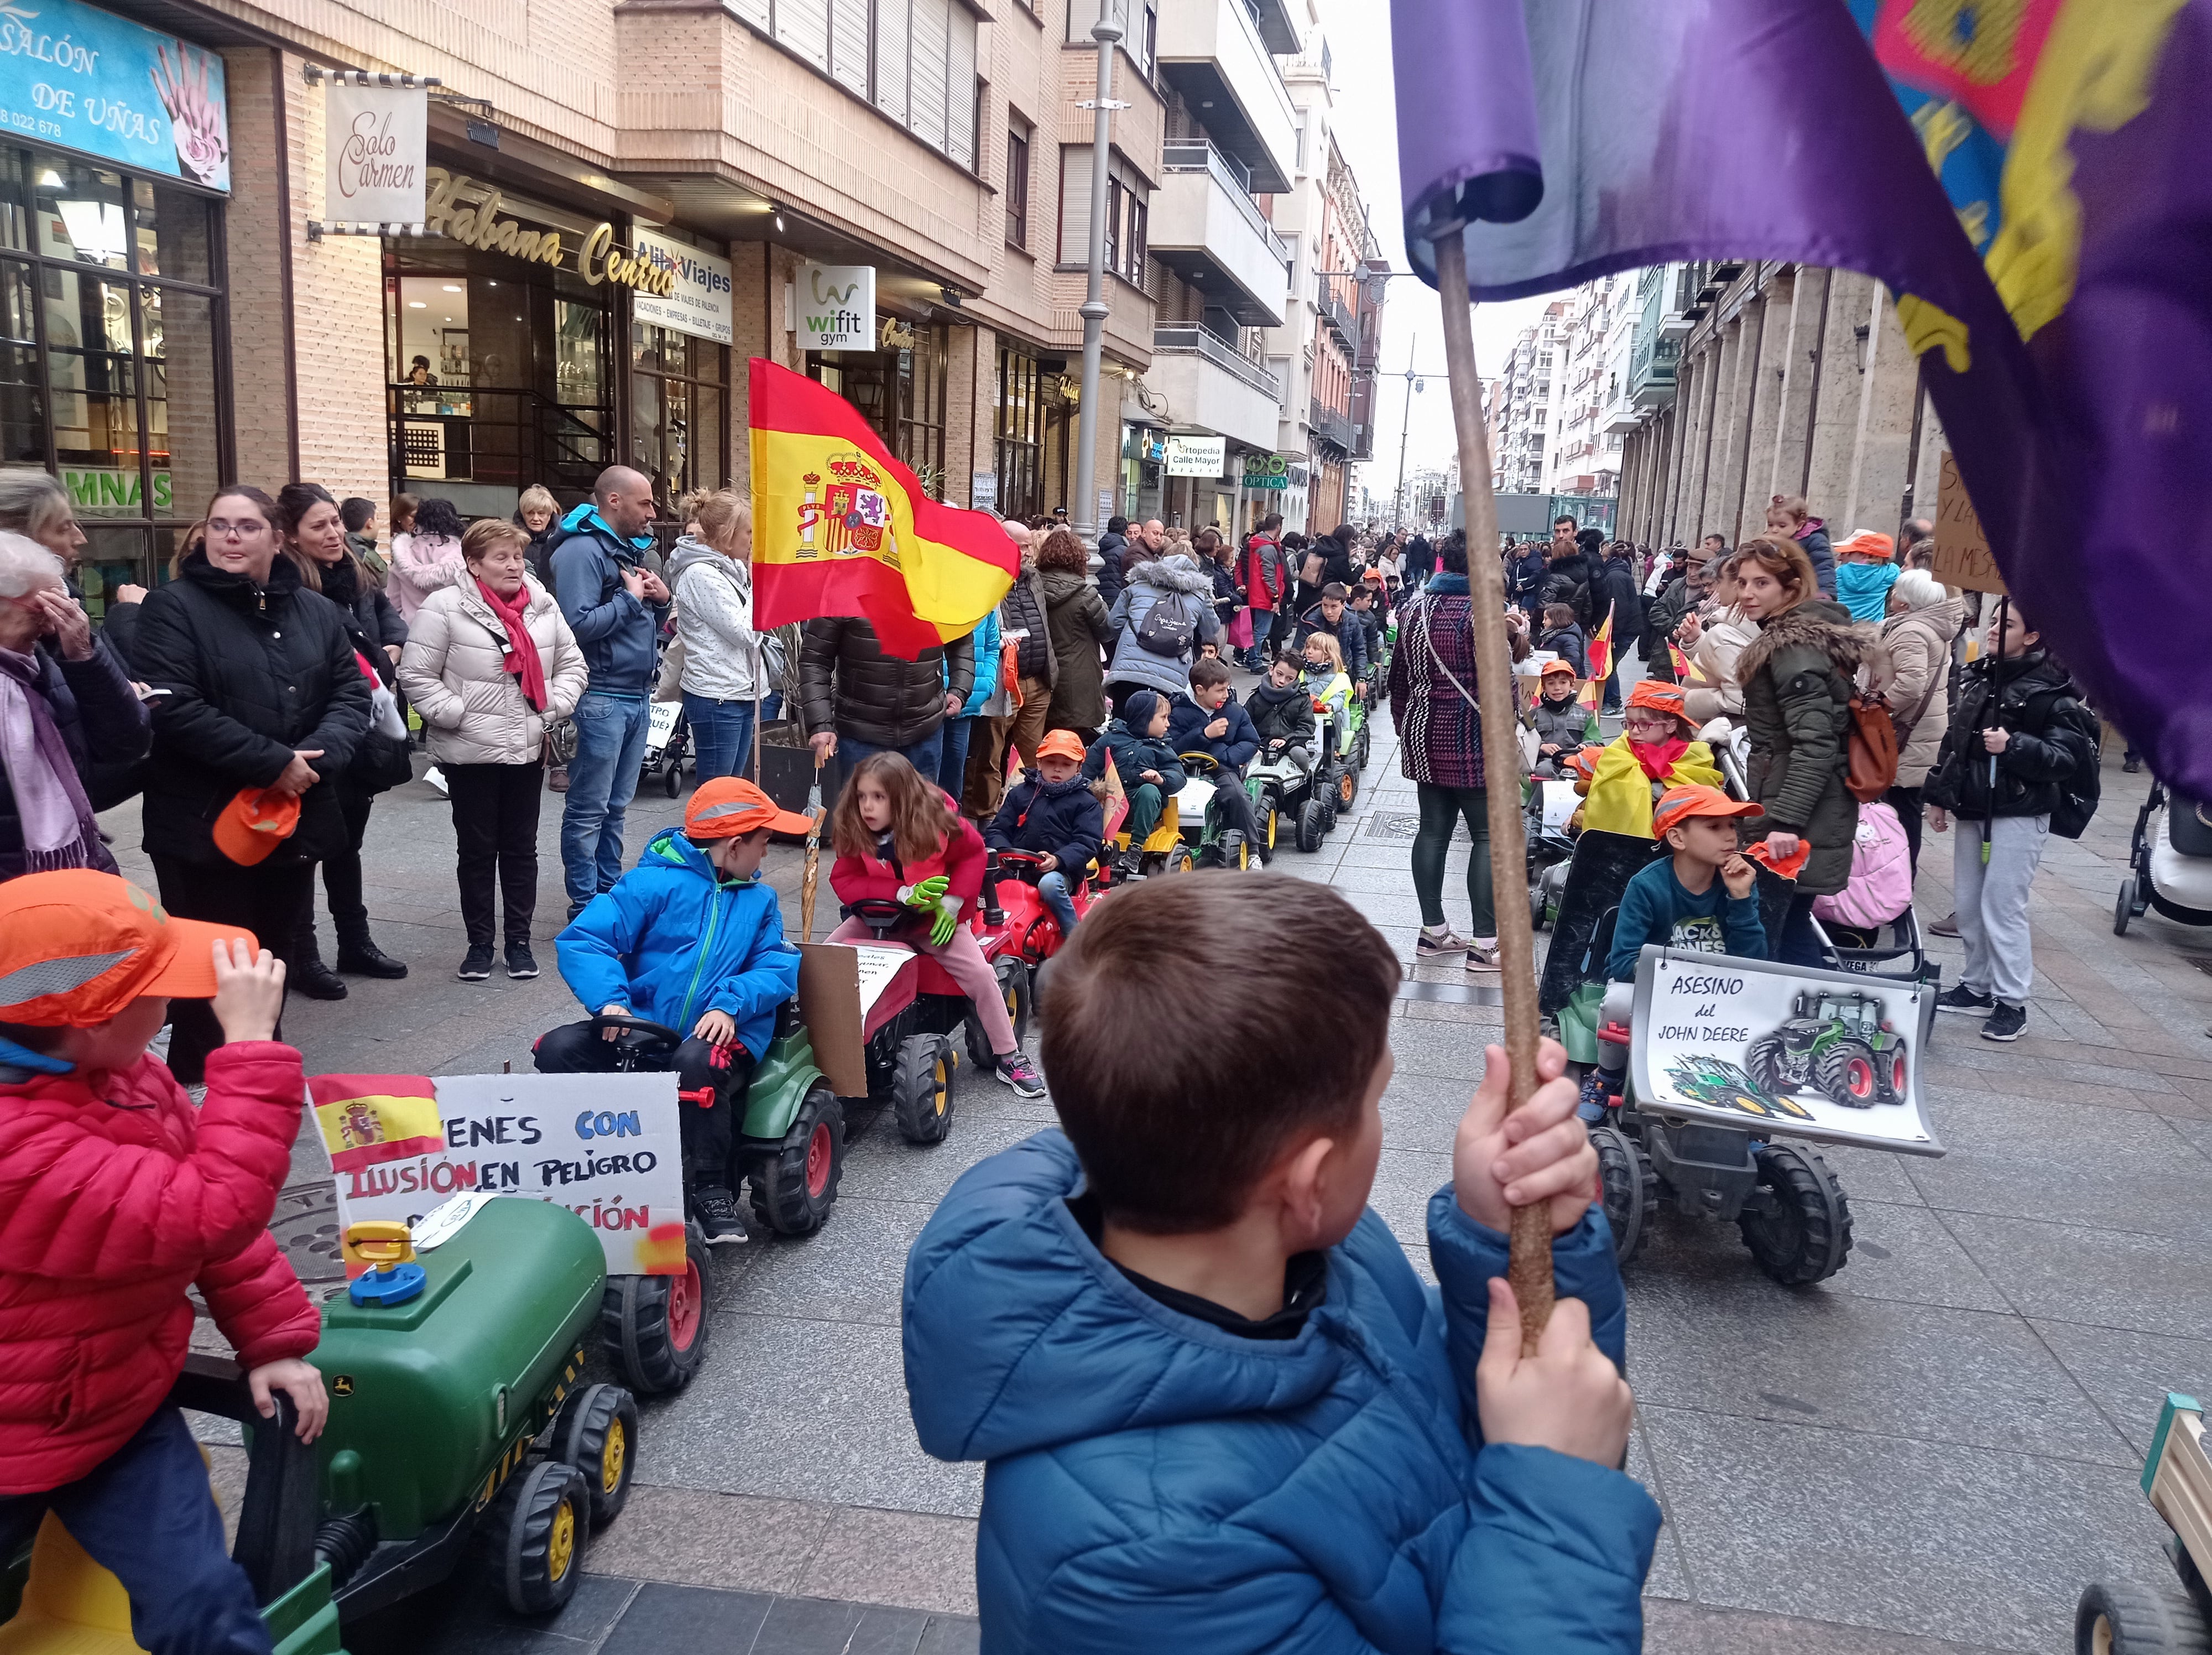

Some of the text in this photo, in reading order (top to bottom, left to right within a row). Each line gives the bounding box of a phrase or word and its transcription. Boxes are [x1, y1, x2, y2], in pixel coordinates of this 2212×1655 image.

[0, 24, 99, 76] SALÓN
[13, 112, 35, 131] 022
[39, 119, 61, 138] 678
[32, 83, 160, 145] DE UÑAS
[348, 111, 395, 165] Solo
[339, 134, 414, 198] Carmen
[426, 166, 674, 296] Habana Centro
[680, 256, 731, 293] Viajes
[637, 300, 662, 316] VACACIONES
[667, 309, 687, 323] EMPRESAS
[692, 316, 711, 330] BILLETAJE
[715, 322, 731, 335] GRUPOS
[674, 292, 680, 301] DE
[681, 294, 694, 306] VIAJES
[695, 298, 701, 308] DE
[702, 300, 719, 314] PALENCIA
[806, 309, 861, 333] wifit
[821, 333, 847, 346] gym
[1195, 456, 1220, 466] Mayor
[1245, 476, 1285, 488] OPTICA
[1671, 976, 1743, 995] ASESINO
[1695, 1003, 1715, 1017] del
[1658, 1026, 1749, 1042] JOHN DEERE
[441, 1110, 641, 1148] ENES CON
[346, 1149, 657, 1200] ILUSIÓN EN PELIGRO
